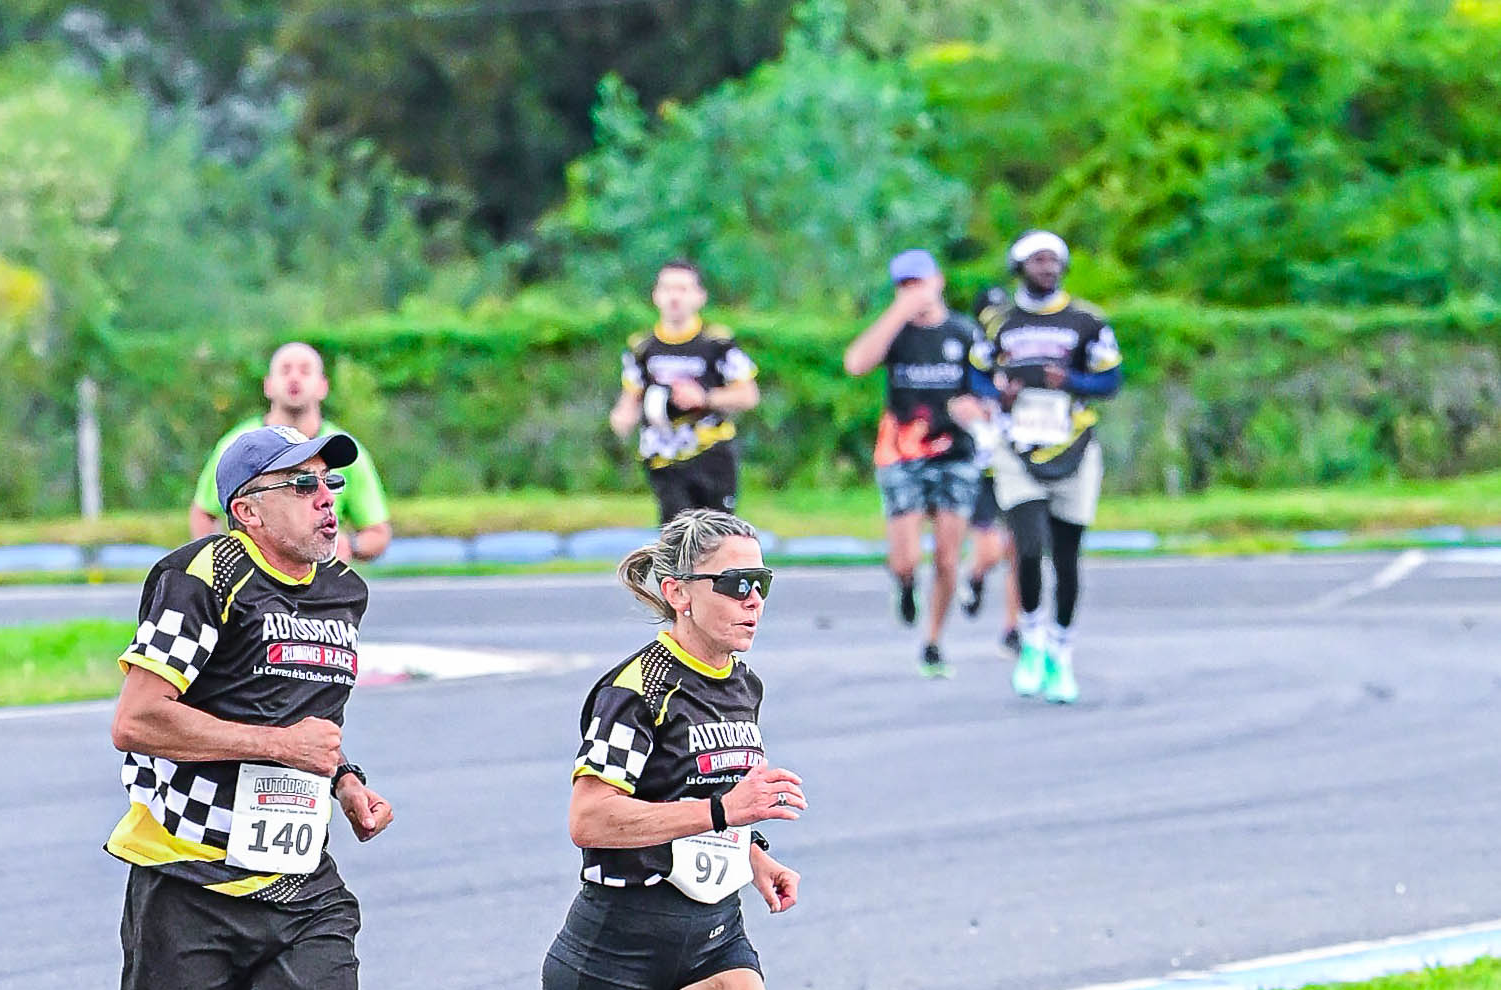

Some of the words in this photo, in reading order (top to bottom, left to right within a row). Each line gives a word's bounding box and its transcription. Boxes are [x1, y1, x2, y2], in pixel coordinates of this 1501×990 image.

[262, 611, 359, 652] AUTÓDROM
[253, 665, 264, 675] La
[324, 648, 354, 671] RACE
[248, 819, 313, 856] 140
[695, 851, 729, 886] 97
